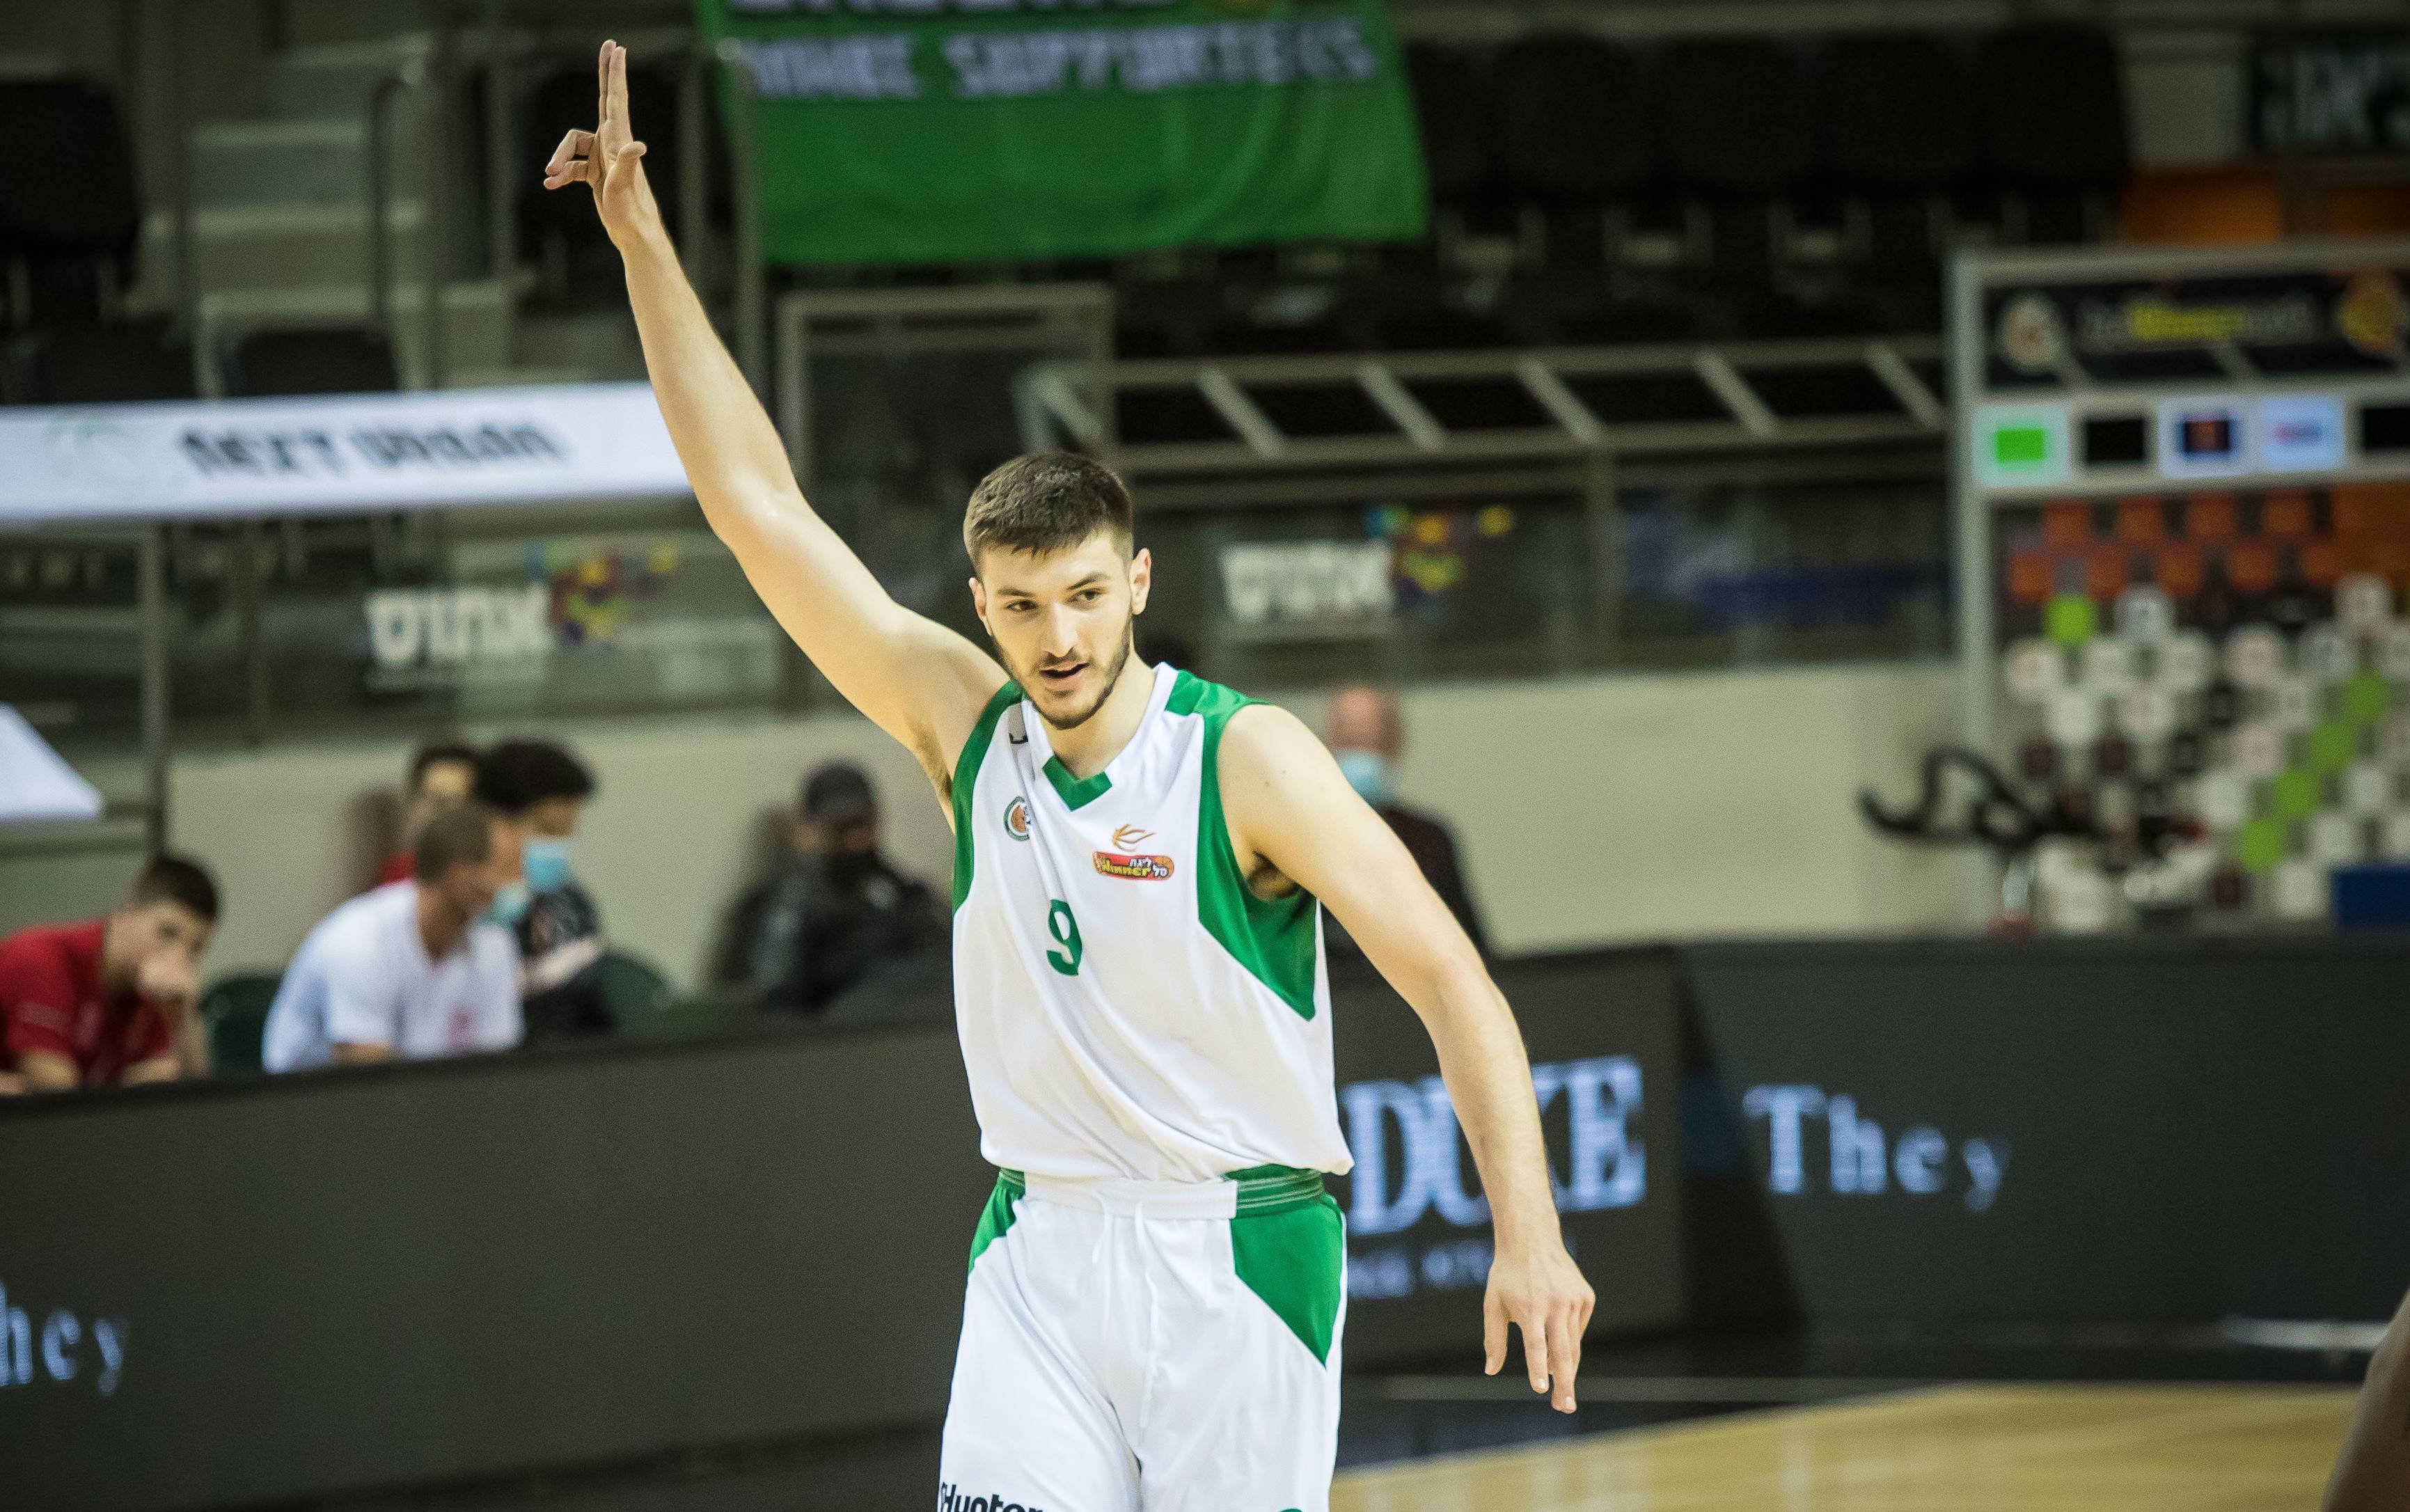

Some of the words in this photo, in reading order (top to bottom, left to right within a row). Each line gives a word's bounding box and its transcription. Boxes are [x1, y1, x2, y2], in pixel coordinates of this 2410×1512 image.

[1046, 899, 1082, 977] 9
[1743, 1083, 2013, 1213] They
[0, 1279, 129, 1397] hey
[940, 1482, 1043, 1512] Hunt
